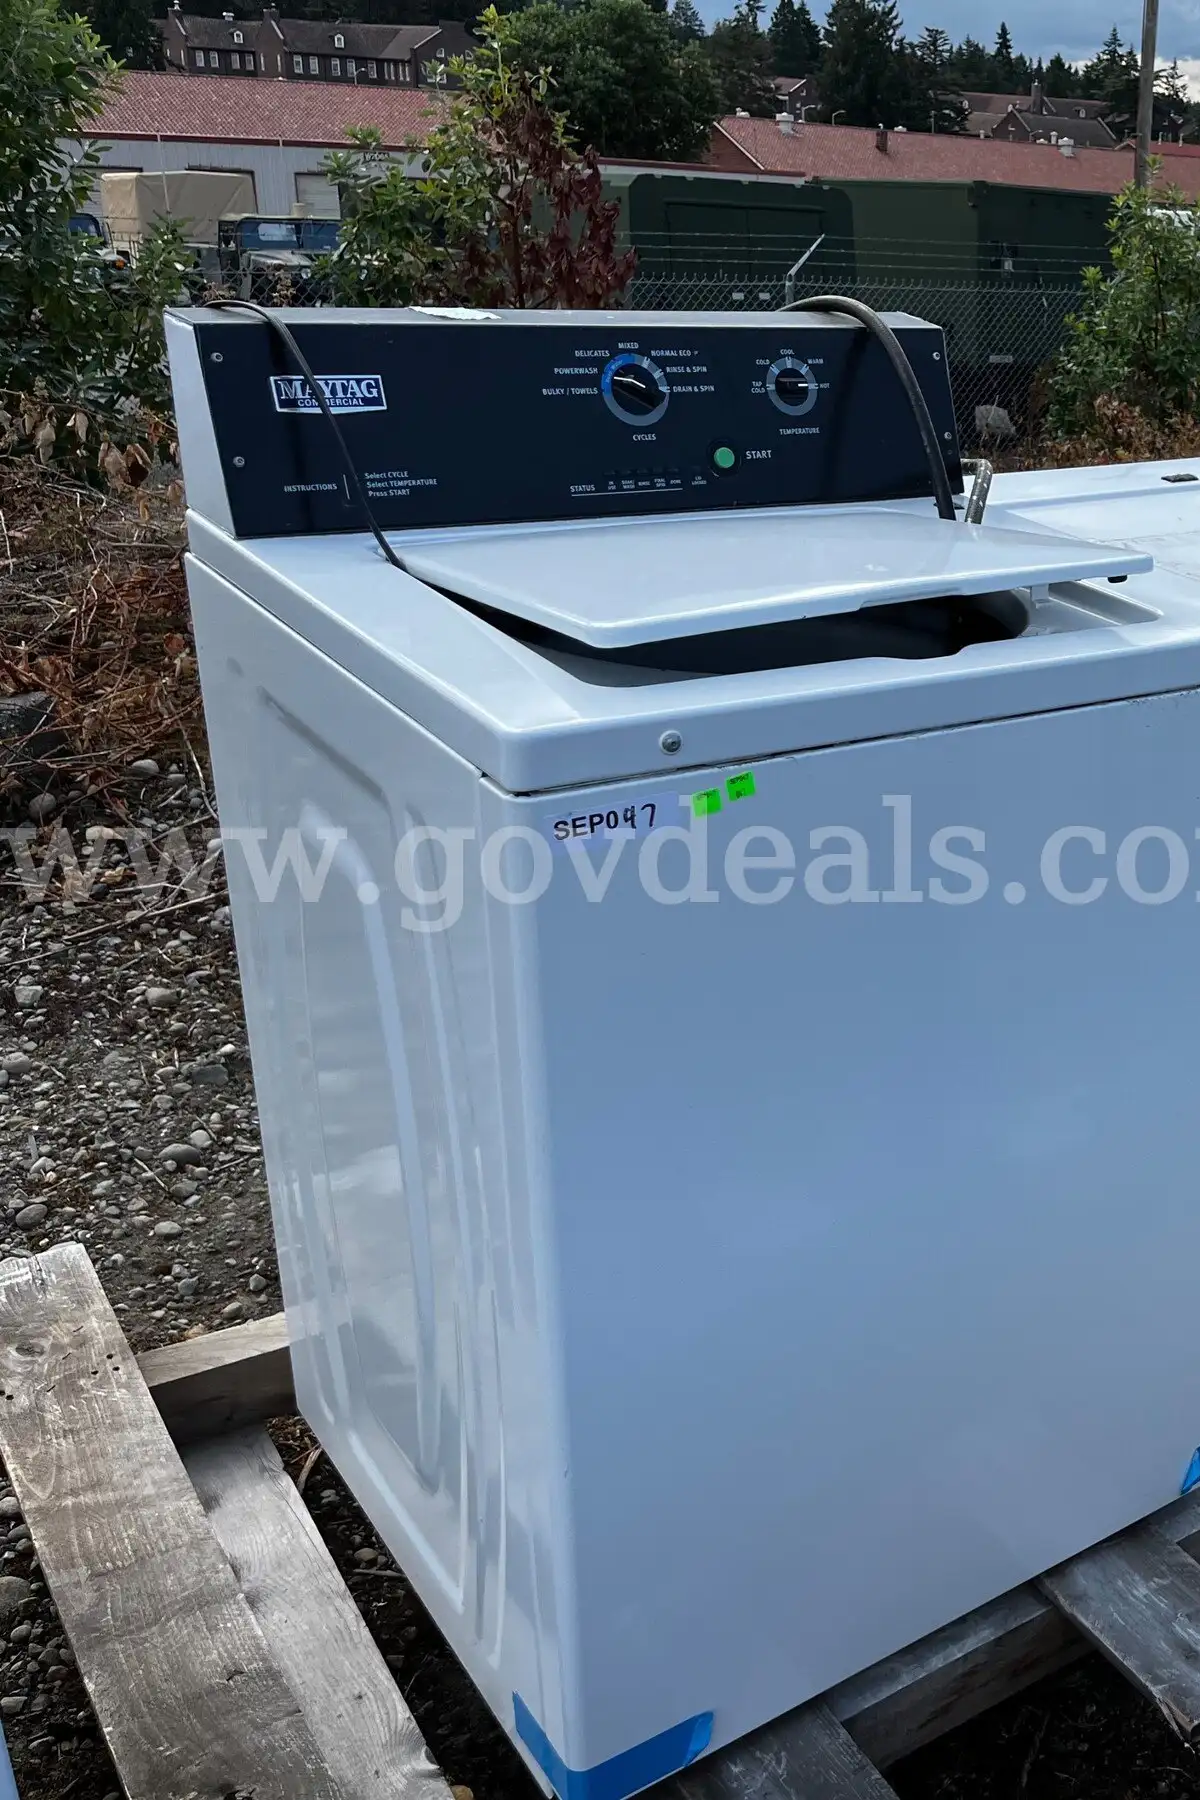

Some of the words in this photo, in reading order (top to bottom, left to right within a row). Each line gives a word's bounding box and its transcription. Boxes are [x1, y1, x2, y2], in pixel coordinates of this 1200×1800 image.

[570, 387, 598, 395] TOWELS
[779, 427, 820, 435] TEMPERATURE
[632, 433, 656, 441] CYCLES
[745, 450, 772, 459] START
[390, 478, 437, 487] TEMPERATURE
[284, 483, 338, 492] INSTRUCTIONS
[570, 485, 595, 493] STATUS
